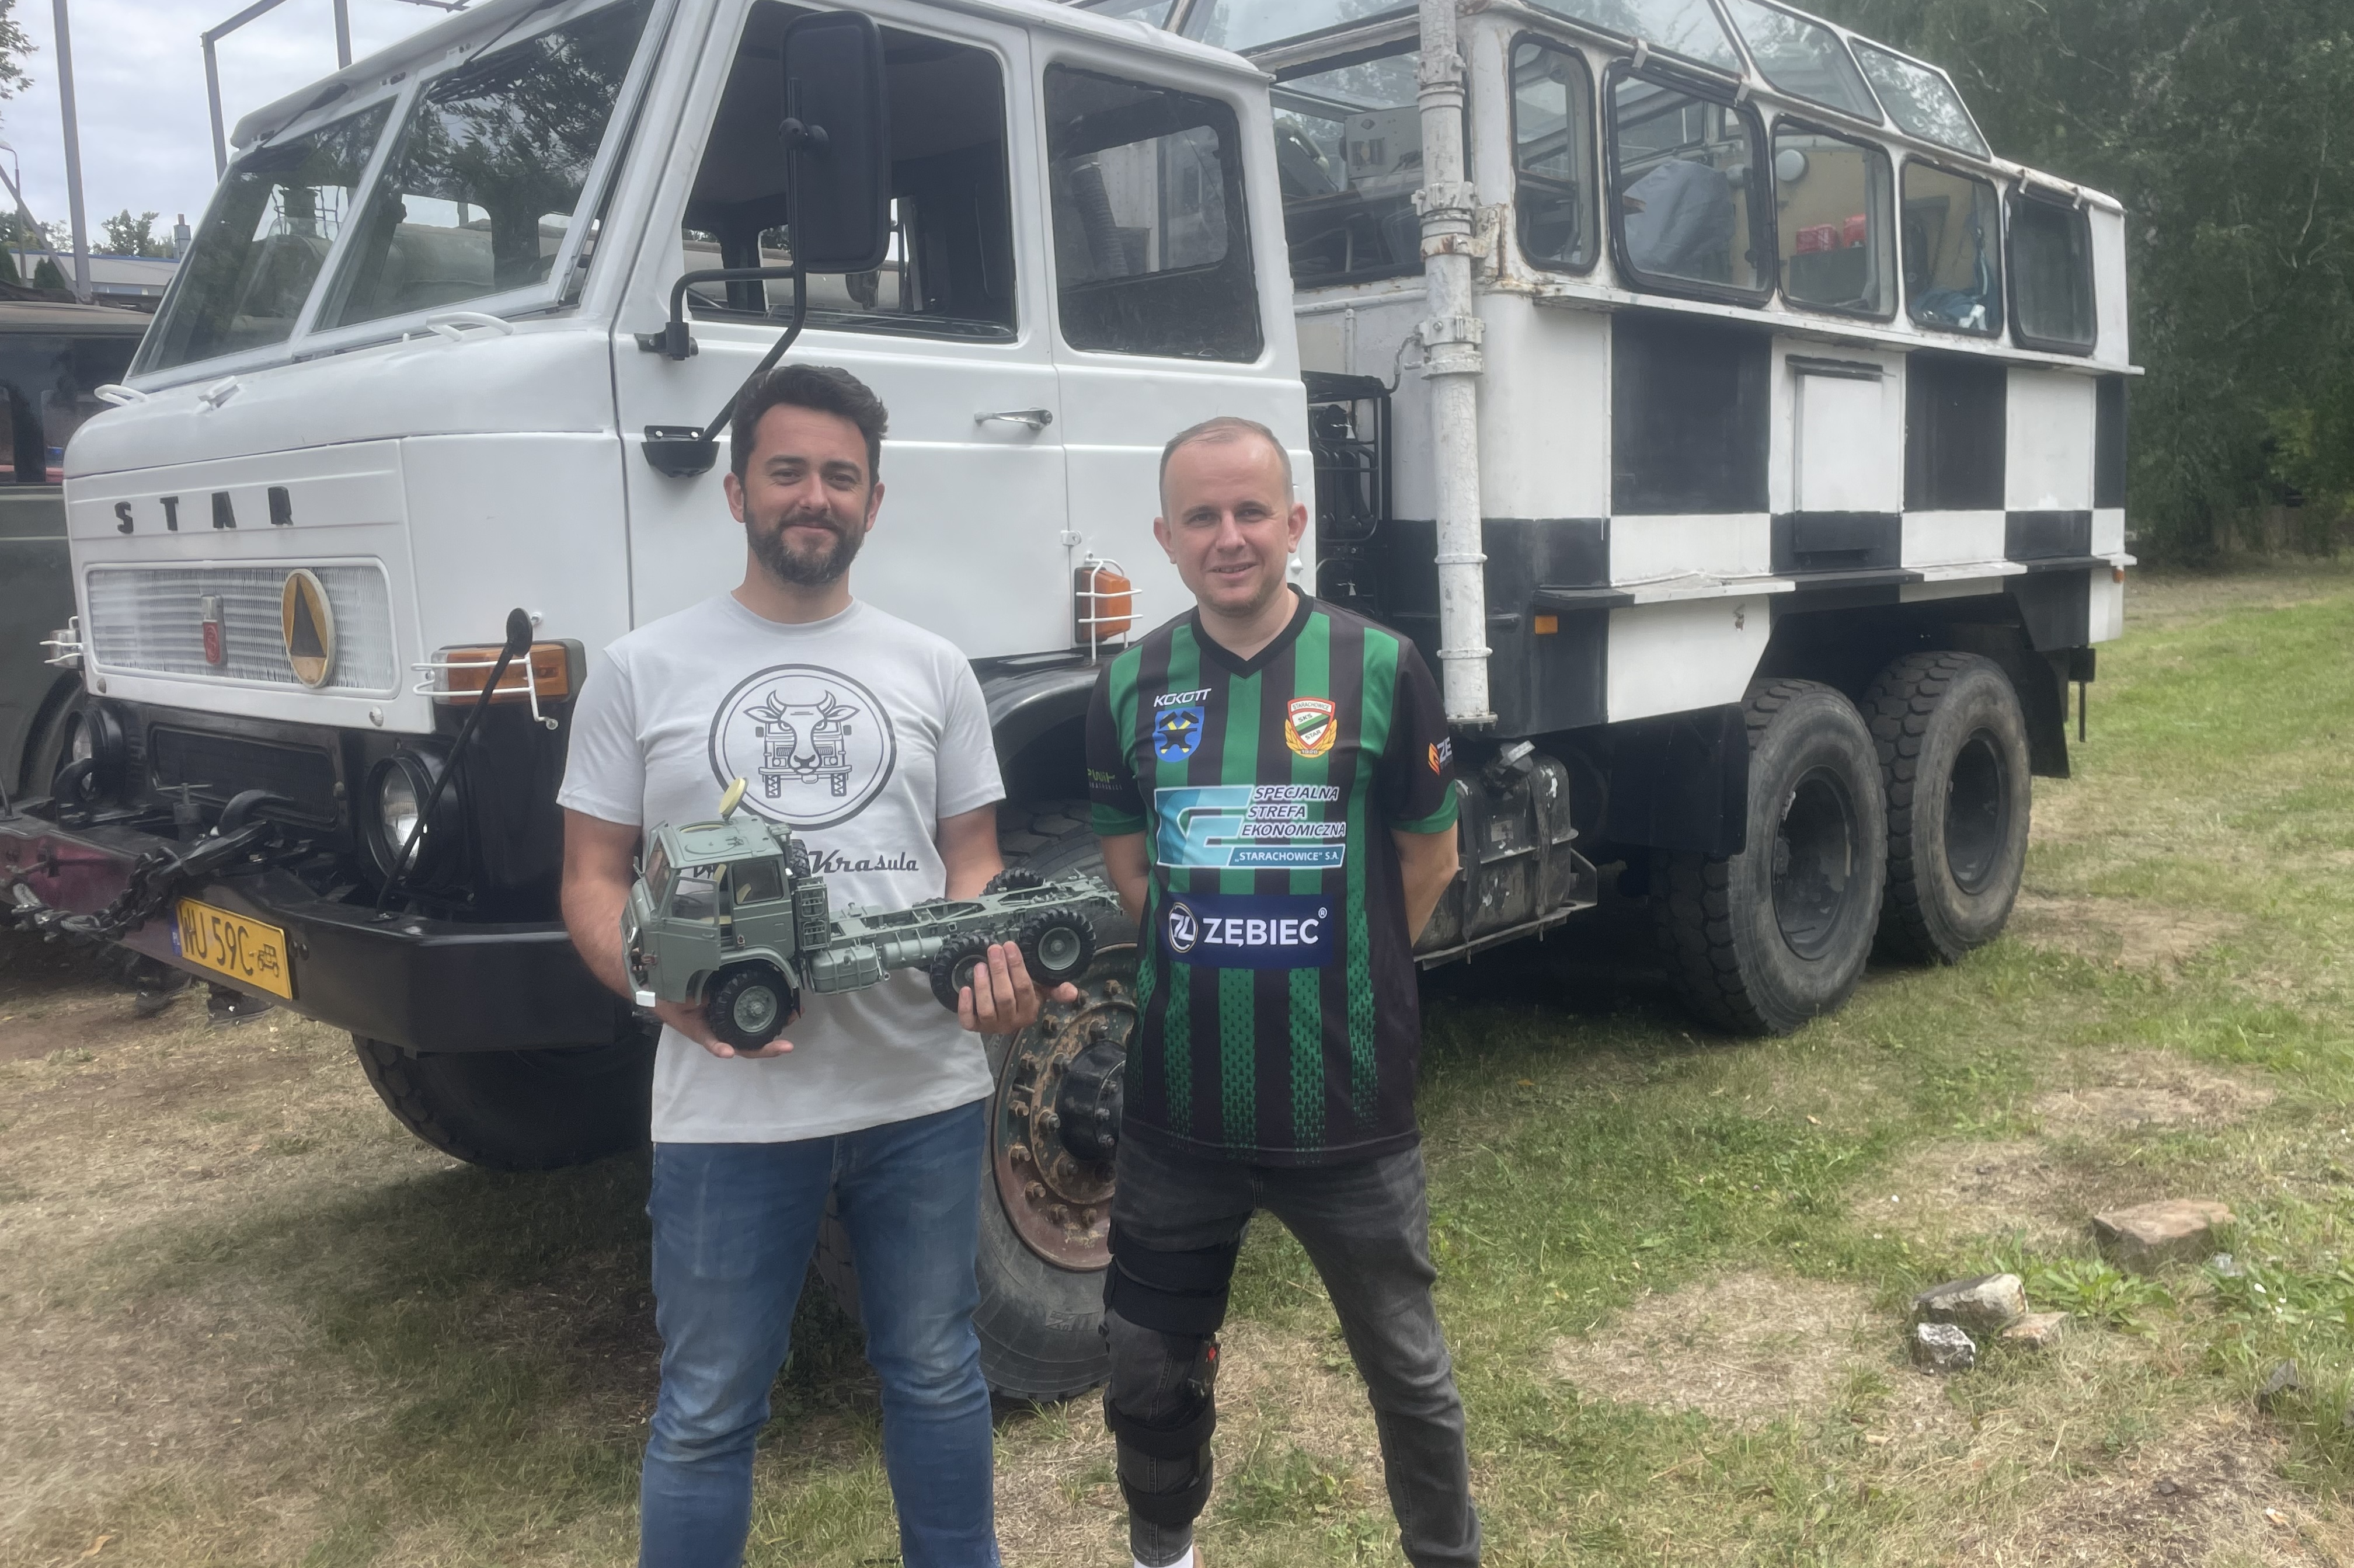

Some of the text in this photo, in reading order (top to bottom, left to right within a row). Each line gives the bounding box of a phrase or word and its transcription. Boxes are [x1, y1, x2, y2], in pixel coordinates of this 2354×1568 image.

[114, 486, 294, 534] STAR
[1154, 688, 1212, 707] KOKOTT
[1292, 702, 1330, 710] STARACHOWICE
[1298, 713, 1313, 723] SKS
[1305, 729, 1322, 740] STAR
[1254, 786, 1339, 800] SPECJALNA
[1248, 805, 1306, 818] STREFA
[1242, 824, 1346, 837] EKONOMICZNA
[808, 849, 920, 874] Krasula
[1325, 851, 1339, 860] S.A.
[211, 915, 253, 976] 59C
